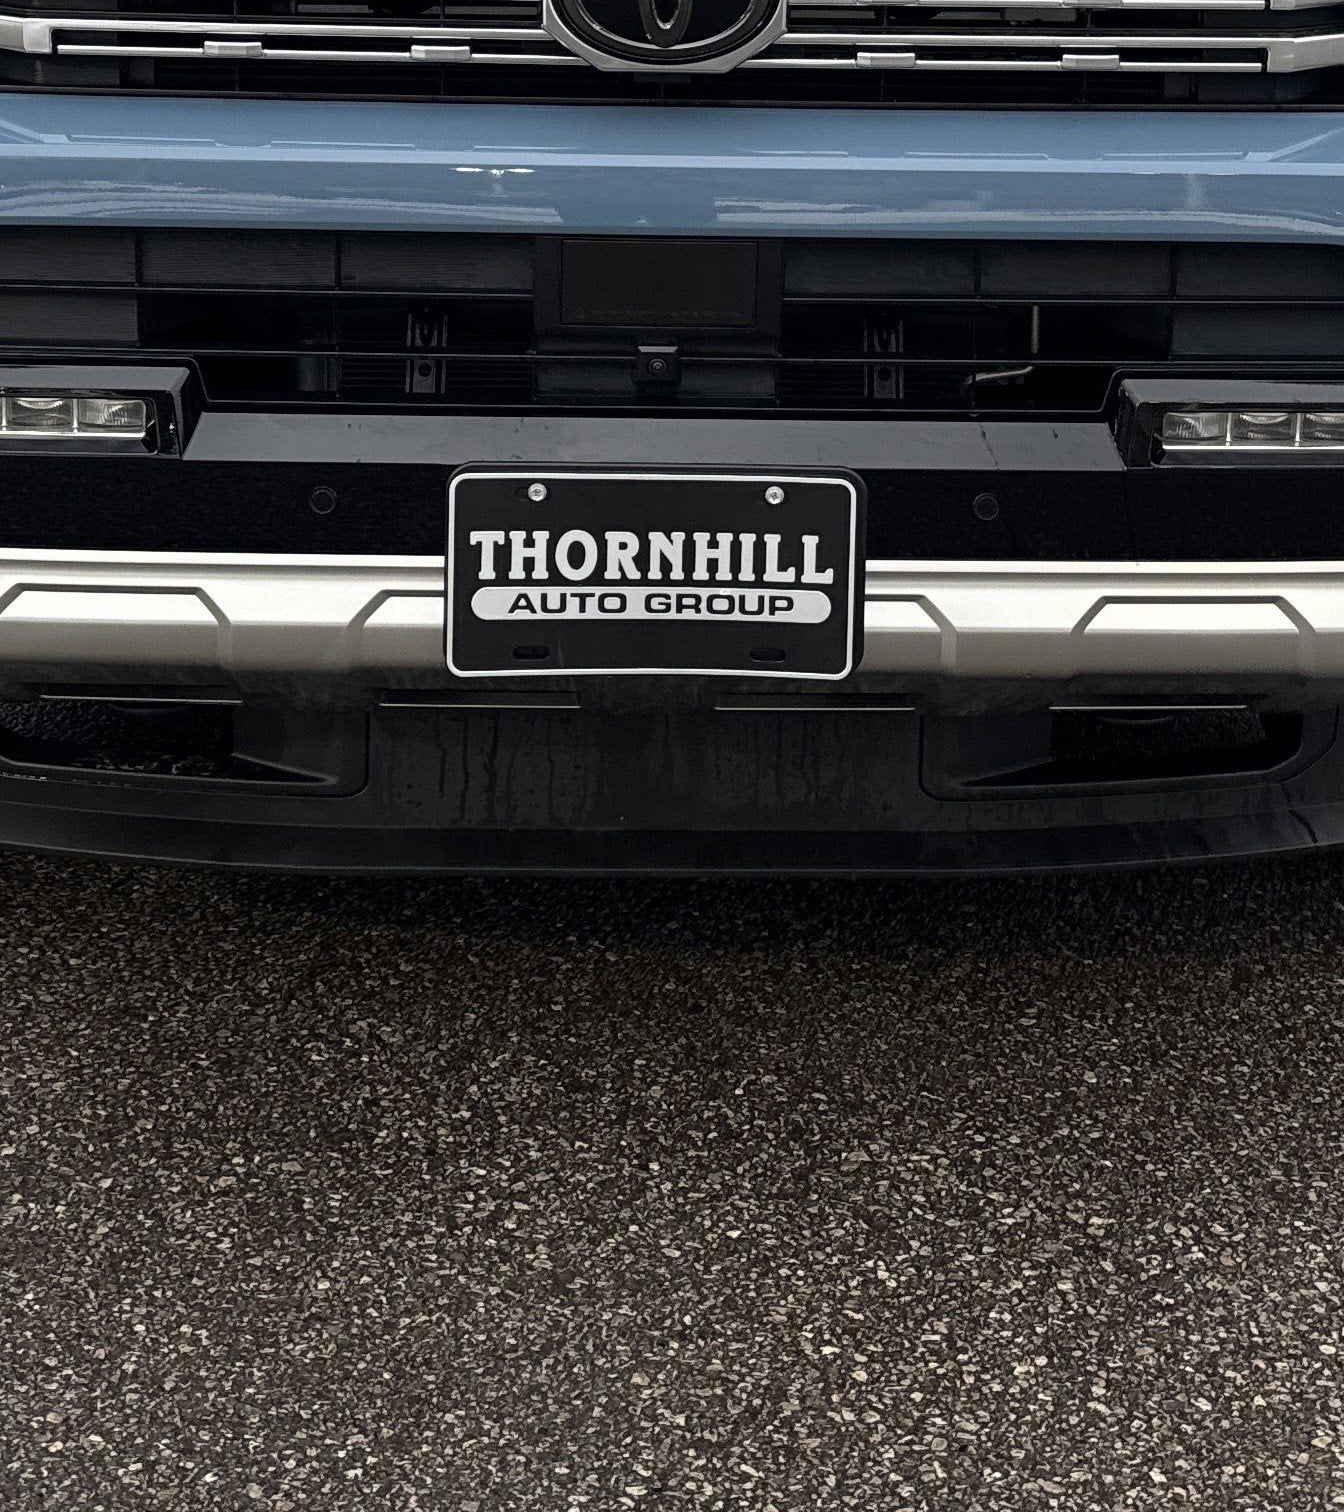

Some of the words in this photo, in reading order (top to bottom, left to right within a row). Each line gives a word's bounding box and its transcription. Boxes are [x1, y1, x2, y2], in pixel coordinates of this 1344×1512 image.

[469, 529, 834, 584] THORNHILL
[507, 593, 627, 614] AUTO
[644, 593, 794, 616] GROUP
